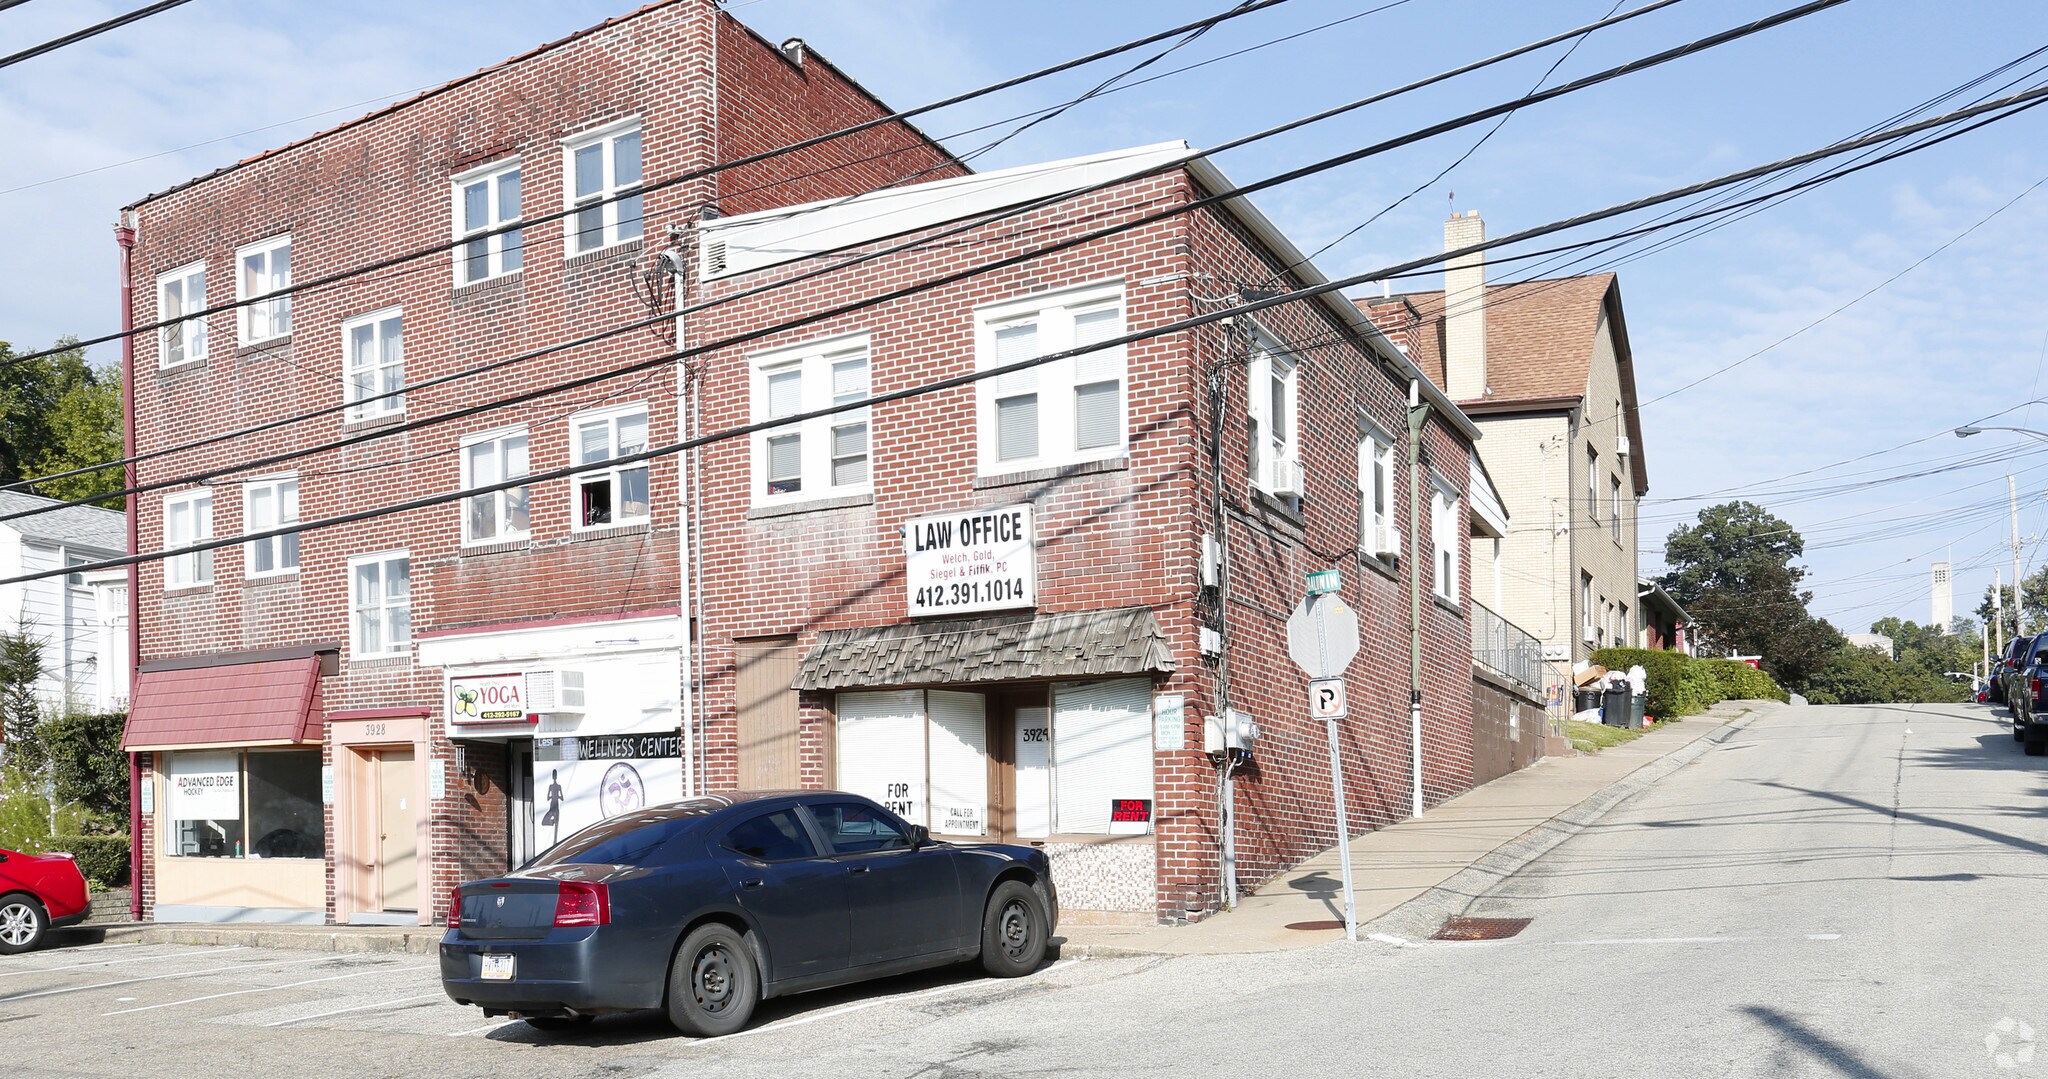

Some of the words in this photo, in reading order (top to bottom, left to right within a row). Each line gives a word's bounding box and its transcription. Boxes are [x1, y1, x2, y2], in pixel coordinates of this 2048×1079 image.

[915, 520, 952, 552] LAW
[959, 512, 1022, 547] OFFICE
[973, 549, 995, 561] Gold,
[930, 567, 956, 581] Siegel
[959, 566, 966, 577] &
[996, 561, 1008, 573] PC
[916, 577, 1023, 608] 412.391.1014
[480, 685, 520, 705] YOGA
[1161, 708, 1178, 716] HOUR
[365, 723, 385, 736] 3928
[578, 738, 635, 758] WELLNESS
[178, 777, 214, 787] ADVANCED
[216, 776, 233, 786] EDGE
[184, 788, 203, 796] HOCKEY
[887, 783, 909, 798] FOR
[1120, 800, 1143, 811] FOR
[950, 807, 962, 817] CALL
[963, 808, 973, 818] FOR
[1113, 811, 1149, 822] RENT
[944, 819, 979, 830] APPOINTMENT
